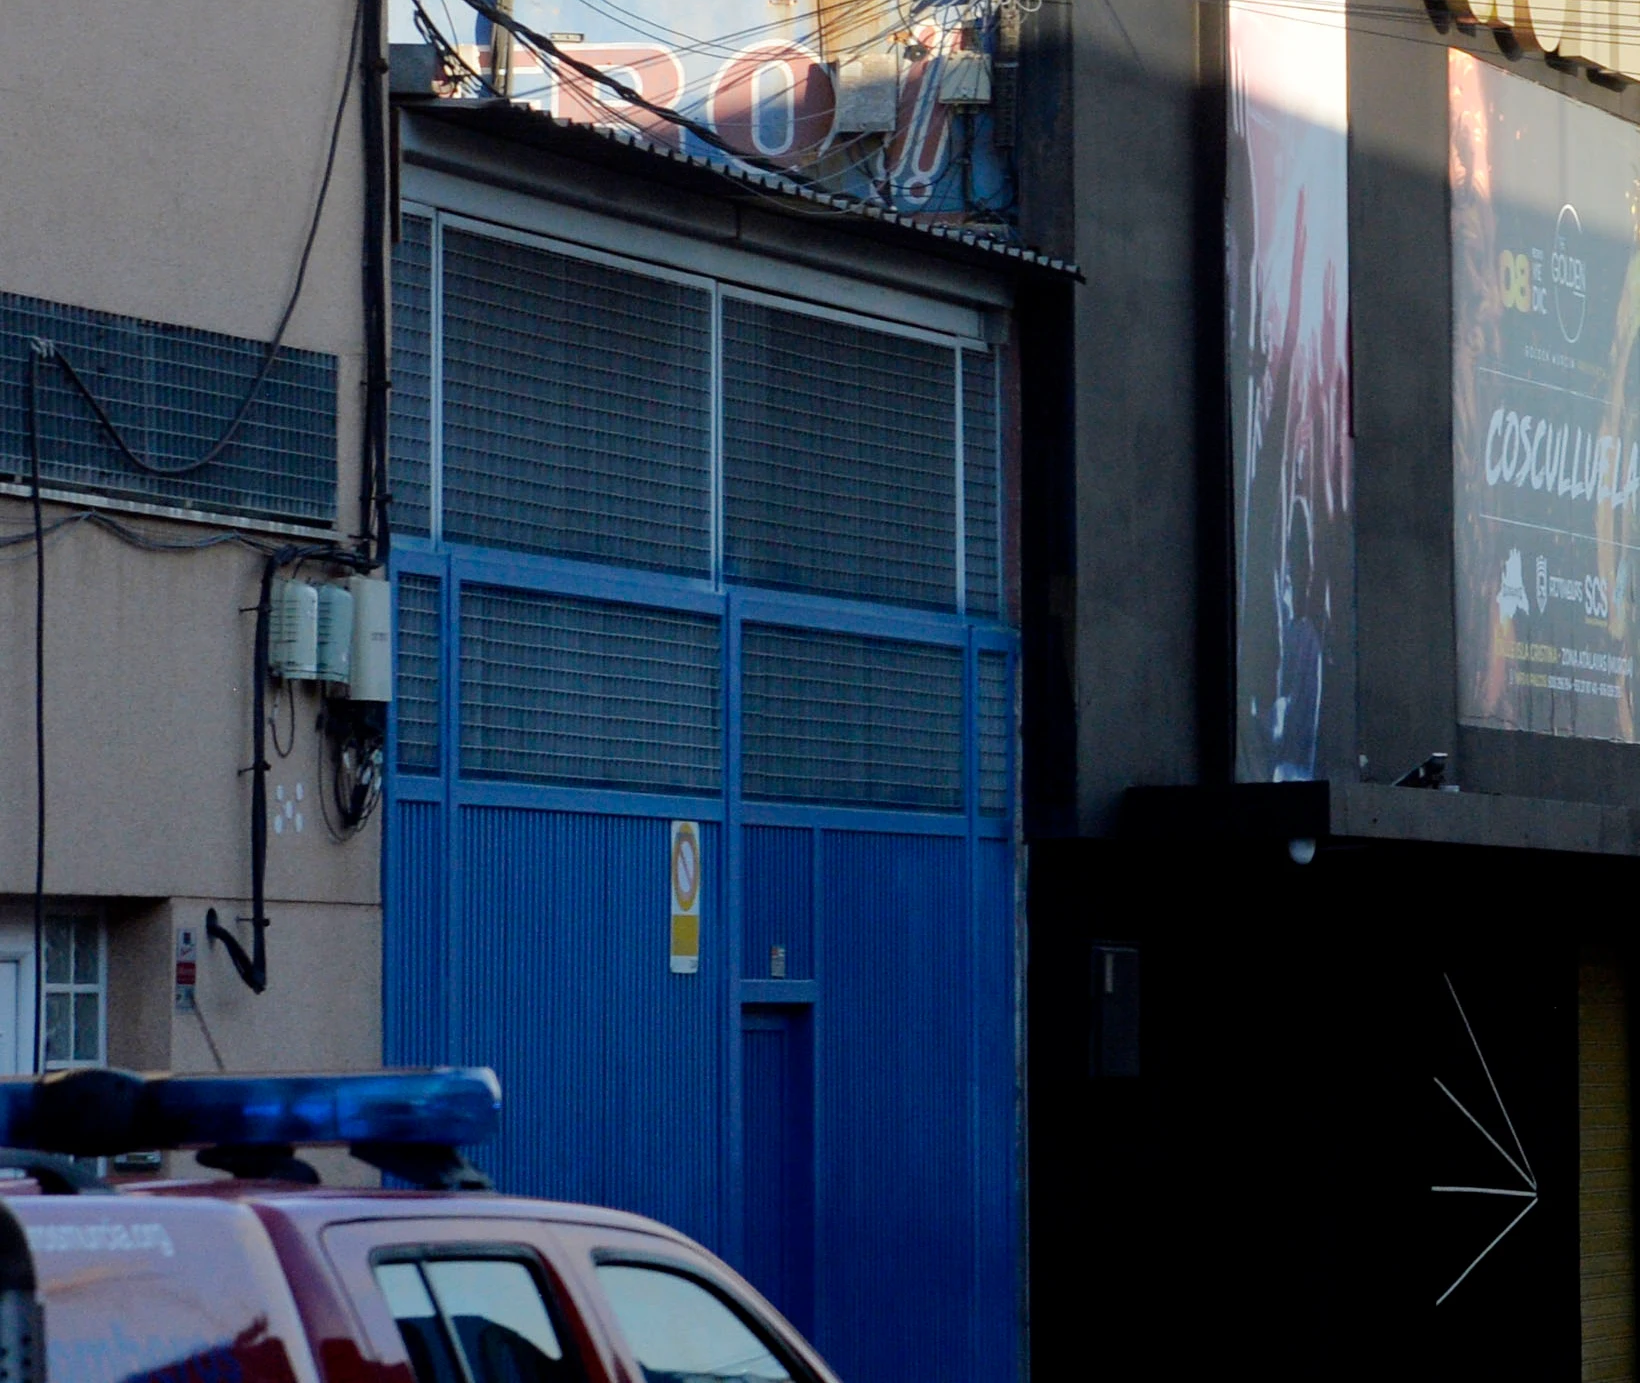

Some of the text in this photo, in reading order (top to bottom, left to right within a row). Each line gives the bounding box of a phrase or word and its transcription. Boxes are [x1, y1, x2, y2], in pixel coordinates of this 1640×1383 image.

[1499, 249, 1532, 313] 08
[1551, 251, 1587, 292] GOLDEN
[1584, 573, 1609, 618] SCS
